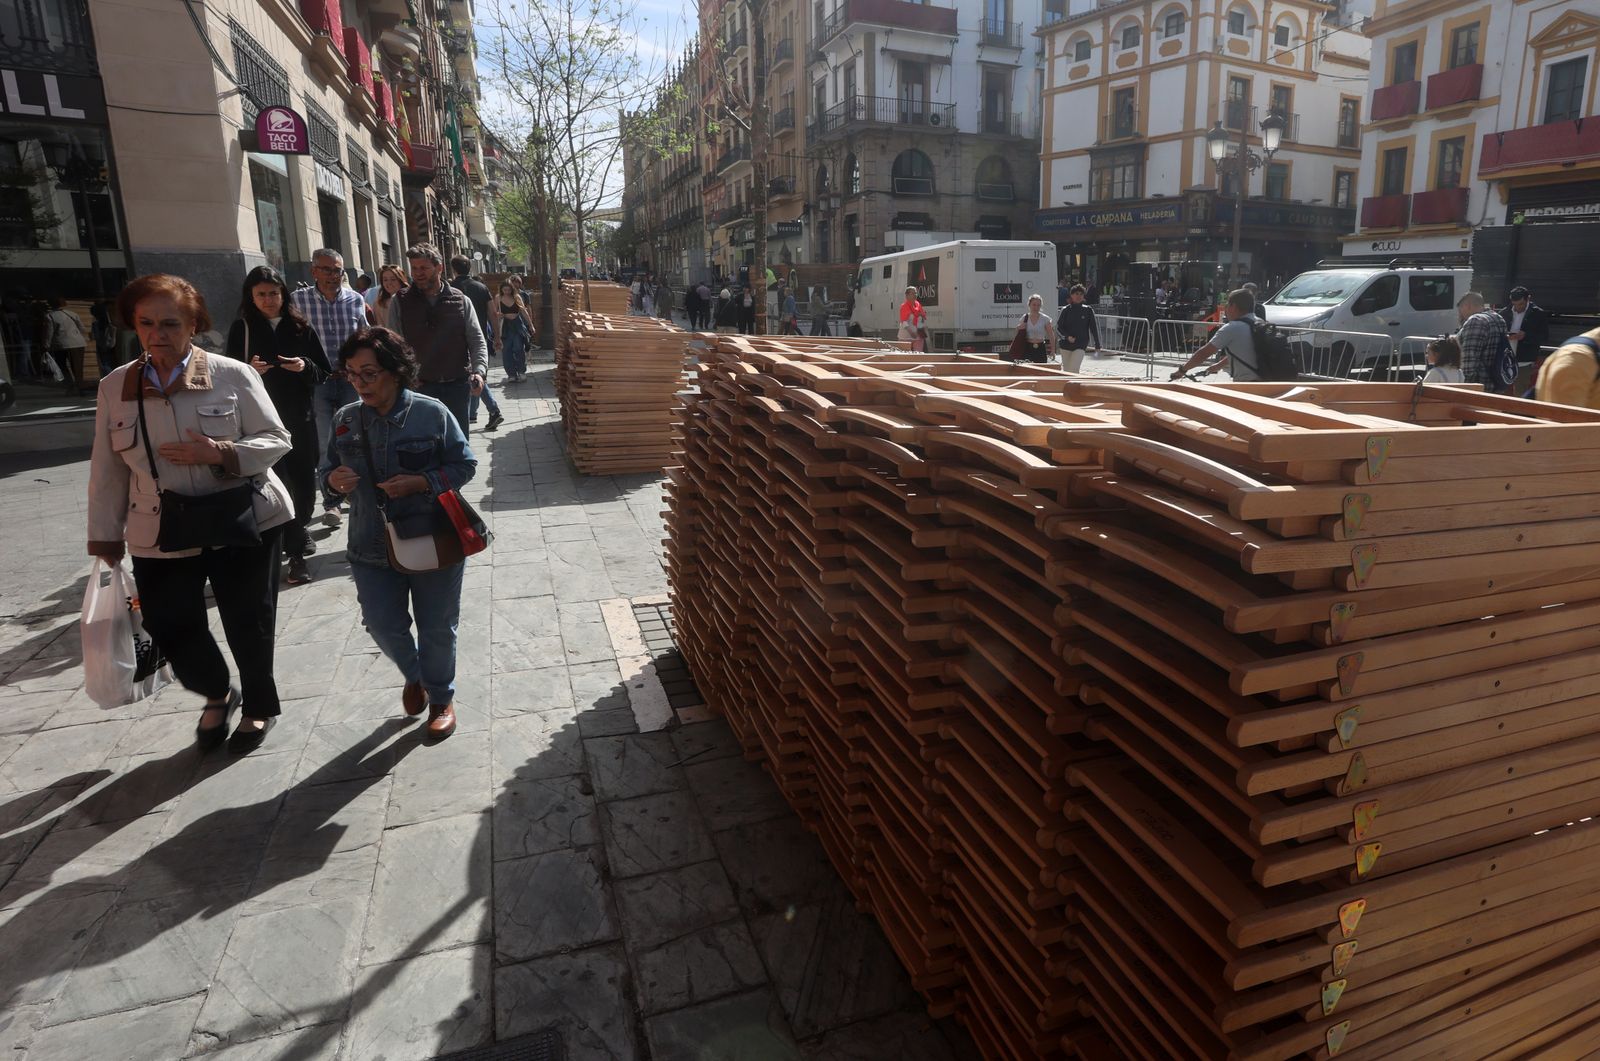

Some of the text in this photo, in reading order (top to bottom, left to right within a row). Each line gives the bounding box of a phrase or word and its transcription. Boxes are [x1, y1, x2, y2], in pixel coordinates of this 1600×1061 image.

[0, 69, 86, 119] LL
[267, 133, 297, 143] TACO
[270, 142, 298, 151] BELL
[1075, 216, 1087, 226] LA
[1090, 212, 1133, 225] CAMPANA
[916, 284, 936, 298] OMIS
[996, 291, 1020, 300] LOOMIS
